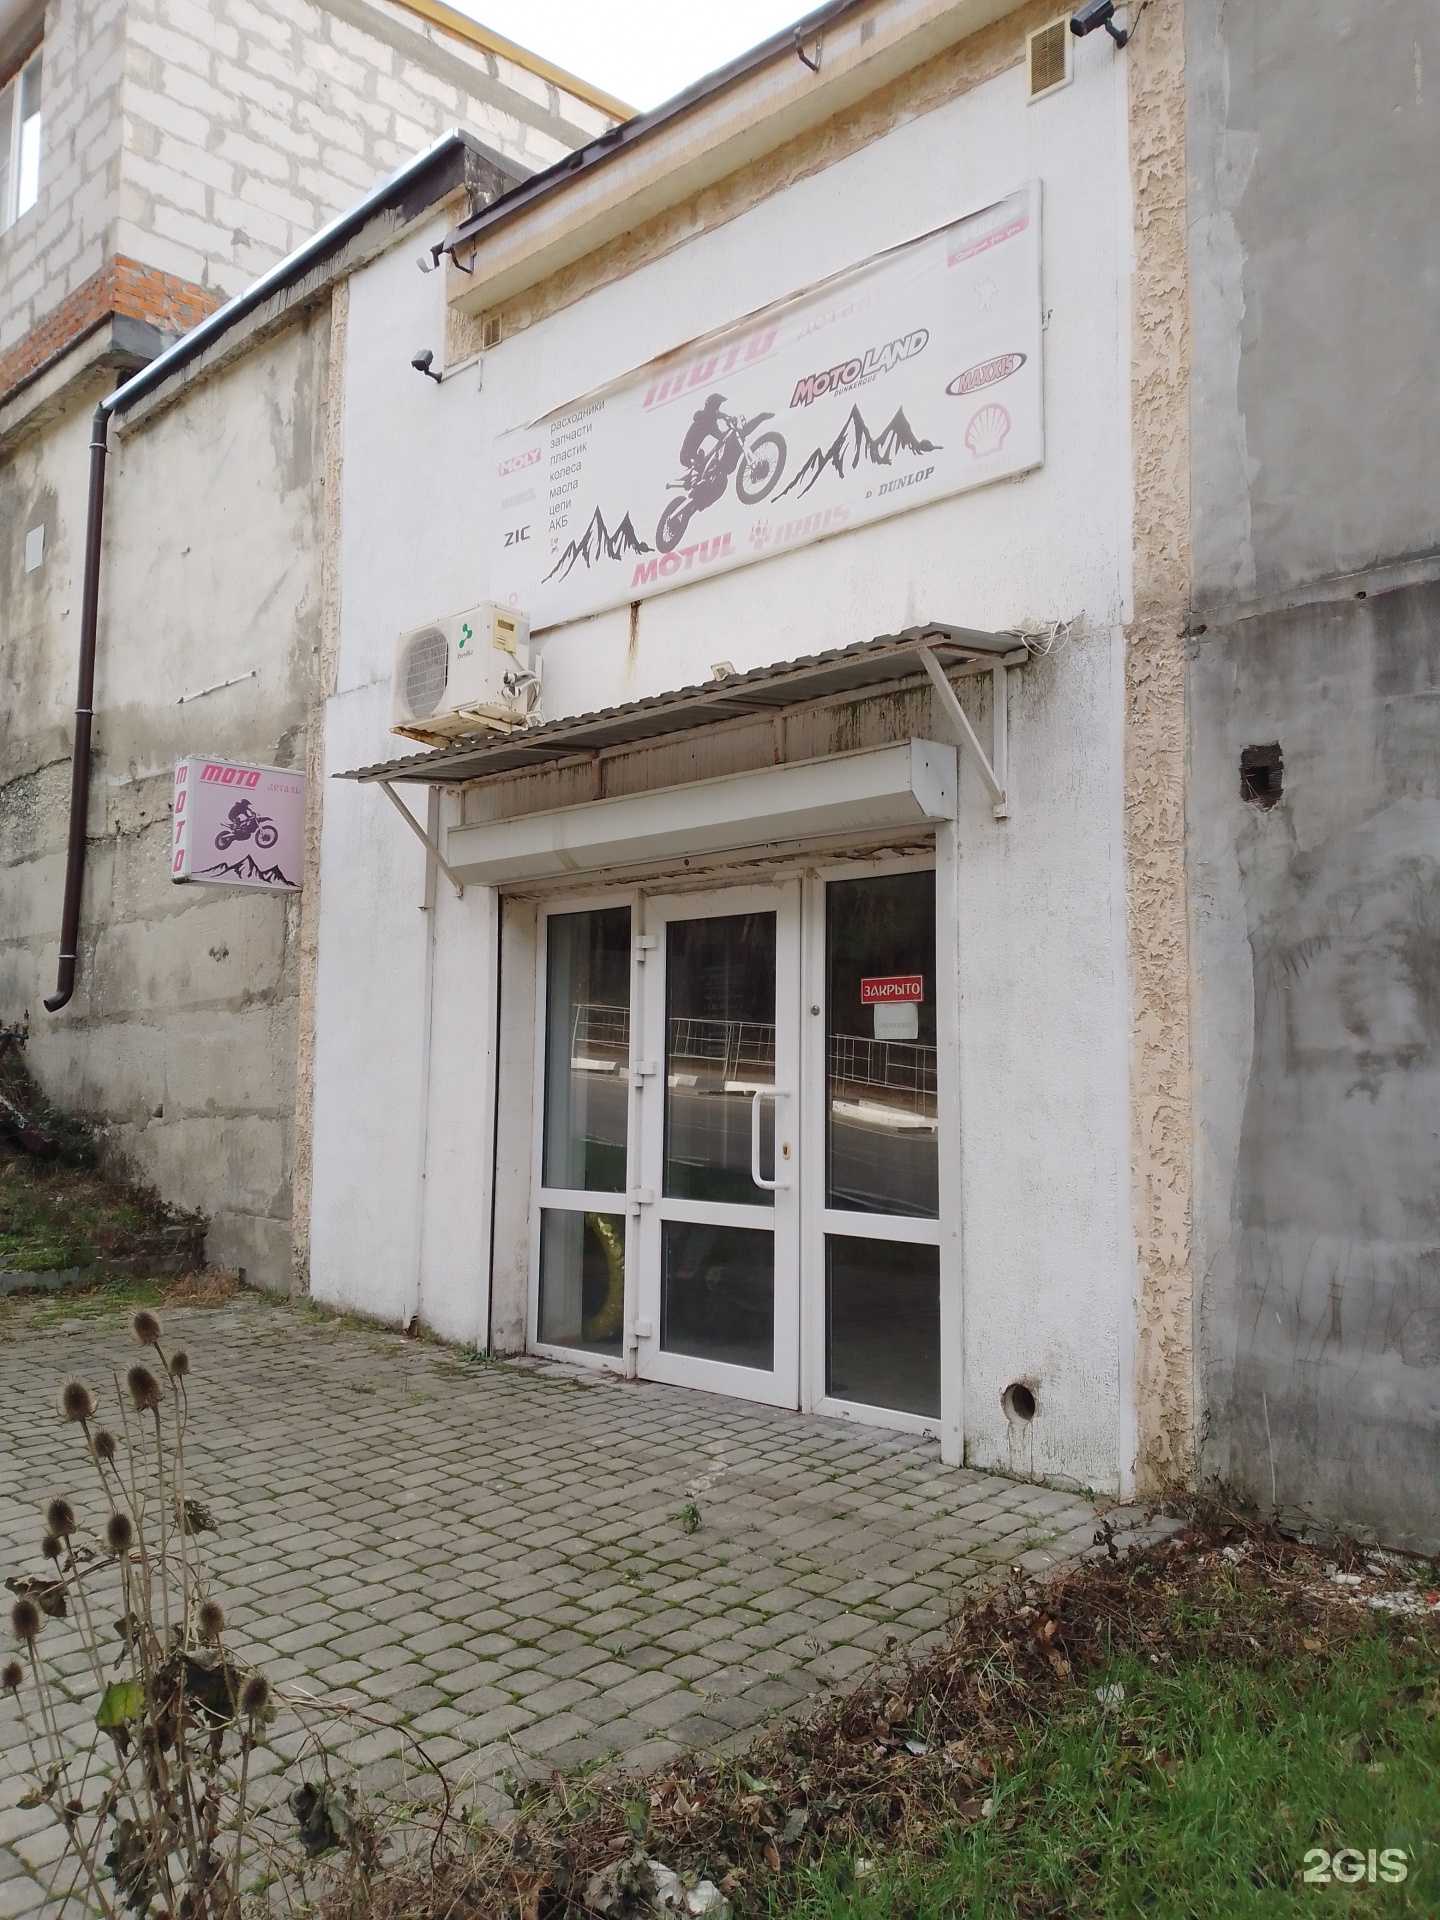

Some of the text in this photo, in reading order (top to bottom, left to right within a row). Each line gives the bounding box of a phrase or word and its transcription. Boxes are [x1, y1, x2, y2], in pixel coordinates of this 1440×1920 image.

[790, 329, 930, 408] MOTOLAND
[958, 352, 1015, 393] MAXXIS
[550, 400, 605, 435] расходники
[550, 421, 593, 448] запчасти
[550, 443, 588, 466] пластик
[549, 461, 582, 482] колеса
[879, 465, 935, 496] DUNLOP
[549, 478, 579, 499] масла
[549, 498, 572, 516] цепи
[549, 514, 568, 532] АКБ
[504, 525, 531, 548] ZIC
[631, 531, 733, 588] MOTUL
[863, 982, 920, 997] ЗАКРЫТО
